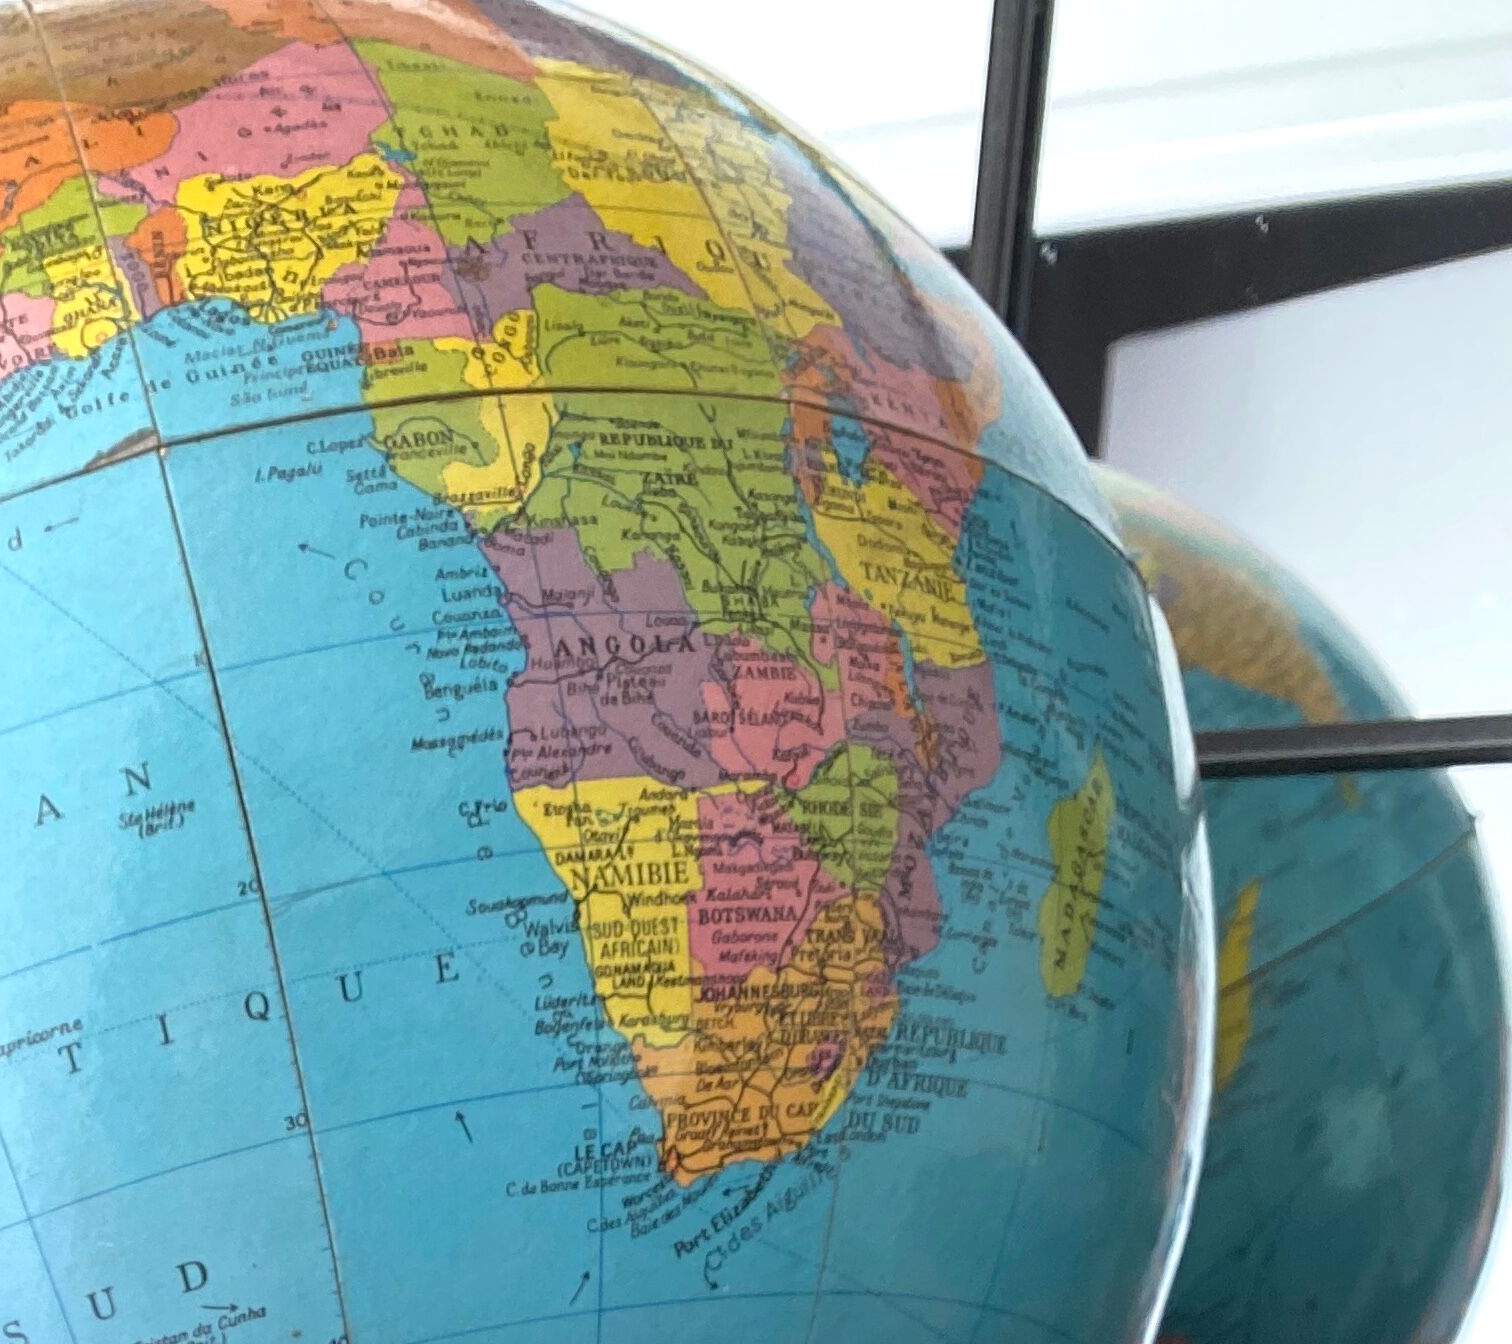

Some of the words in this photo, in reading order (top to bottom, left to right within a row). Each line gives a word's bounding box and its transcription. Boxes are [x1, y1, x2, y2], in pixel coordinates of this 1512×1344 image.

[383, 429, 455, 450] GABON
[554, 633, 697, 659] ANGOLA
[570, 861, 690, 891] NAMIBIE
[698, 905, 797, 925] BOTSWANA
[284, 1112, 310, 1131] 30
[557, 1156, 652, 1177] (CAPETOWN)
[191, 1323, 213, 1338] da
[217, 1305, 268, 1331] Cunha
